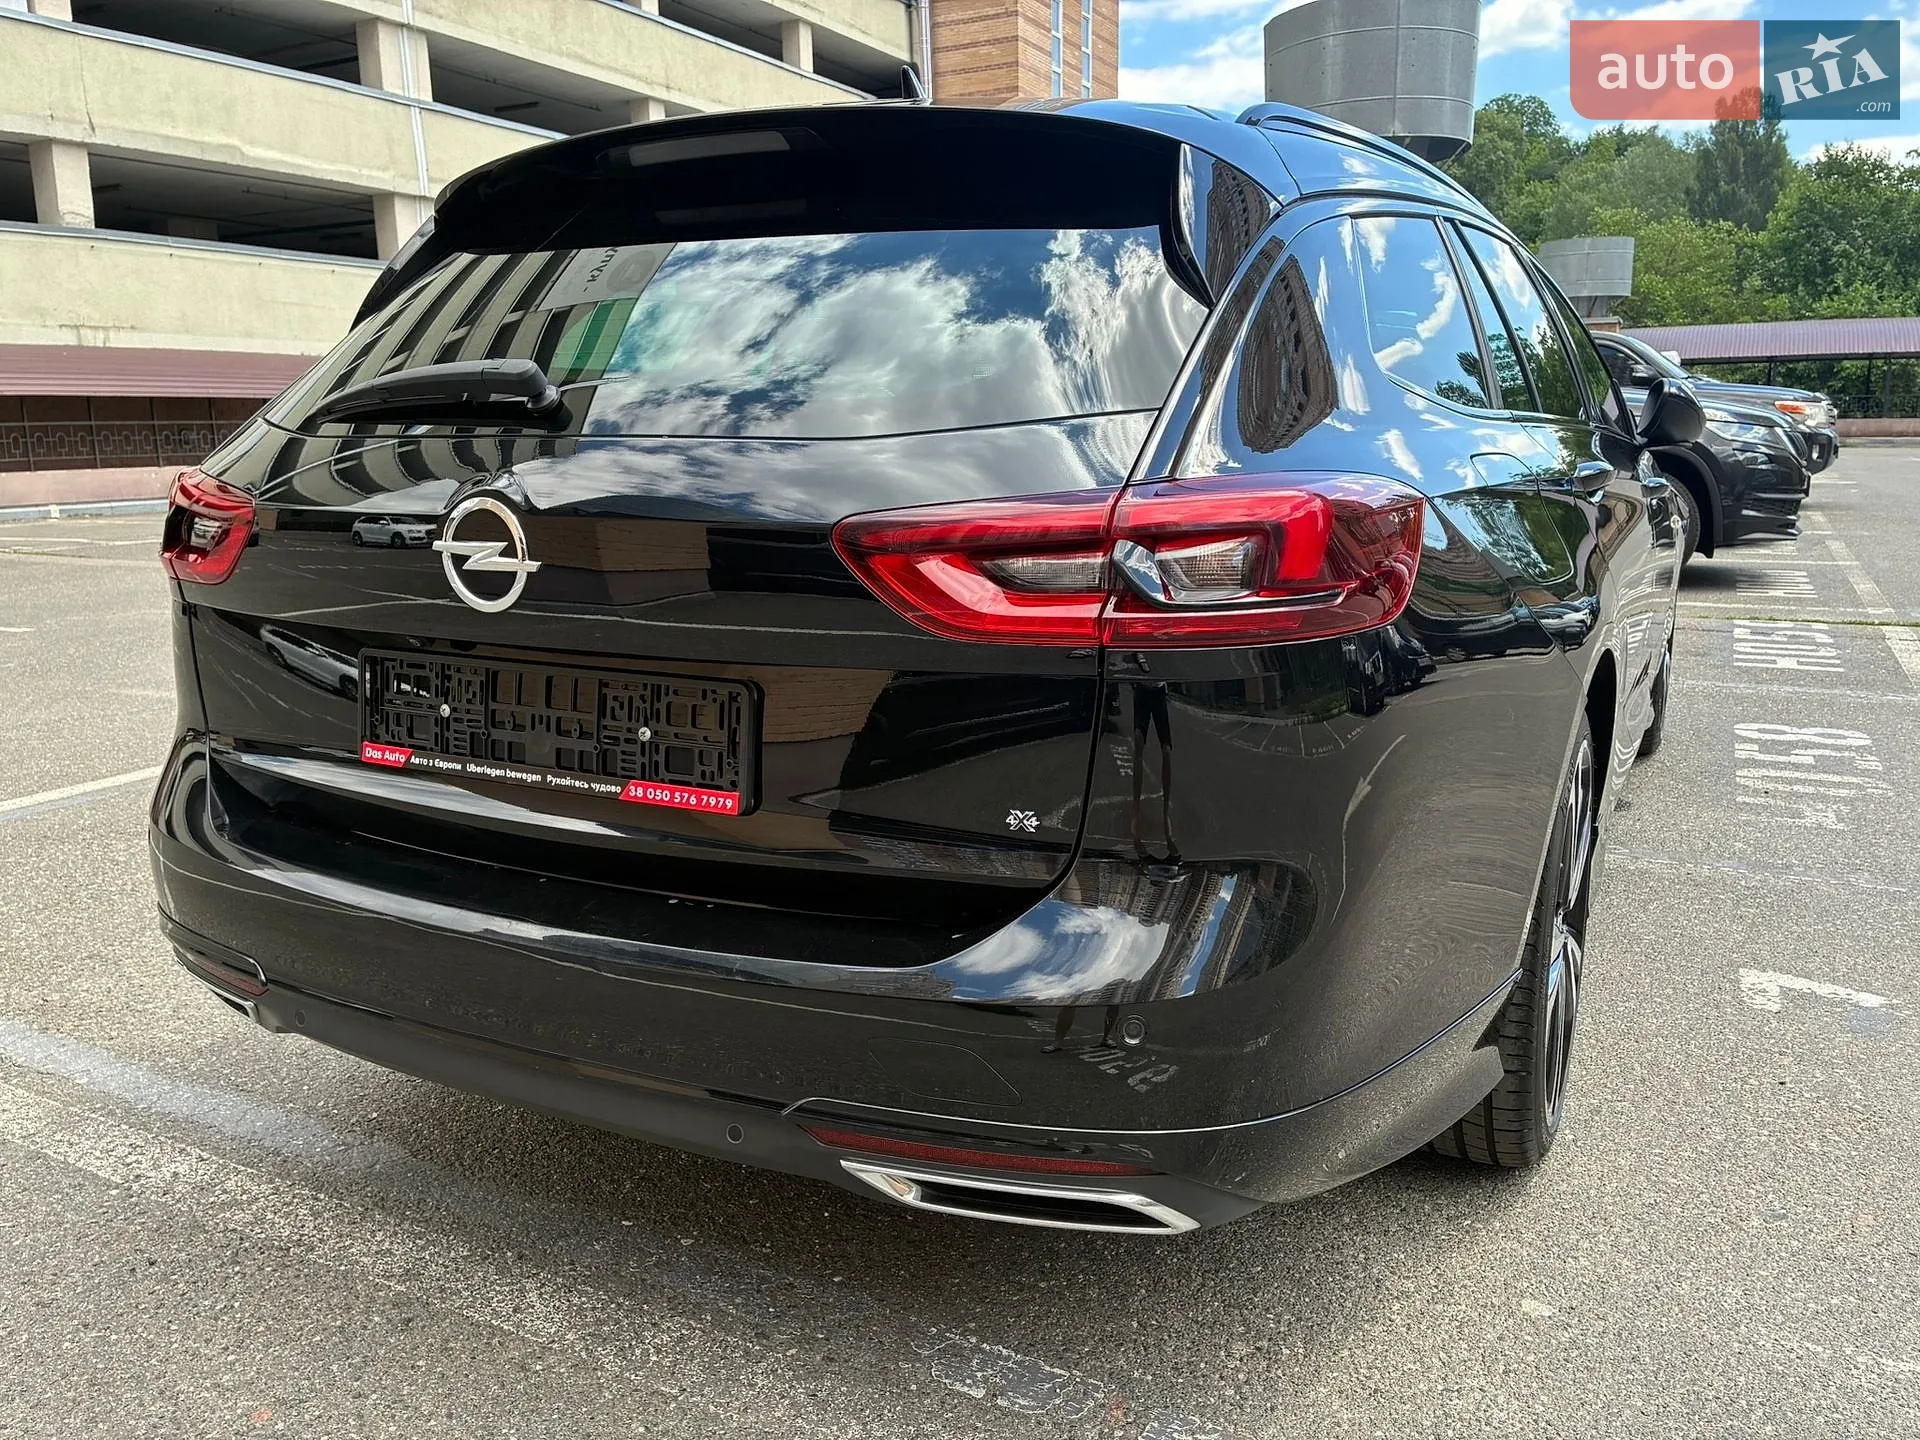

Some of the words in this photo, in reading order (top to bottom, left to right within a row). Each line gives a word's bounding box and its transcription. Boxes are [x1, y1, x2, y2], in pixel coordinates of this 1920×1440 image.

[365, 747, 382, 760] Das
[384, 749, 406, 763] Auto
[410, 755, 428, 766] Авто
[434, 759, 462, 771] Європи
[506, 768, 542, 783] bewegen
[546, 774, 589, 789] Рухайтесь
[590, 782, 622, 793] чудово
[628, 785, 644, 797] 38
[646, 787, 671, 801] 050
[674, 791, 697, 805] 576
[700, 795, 733, 810] 7979
